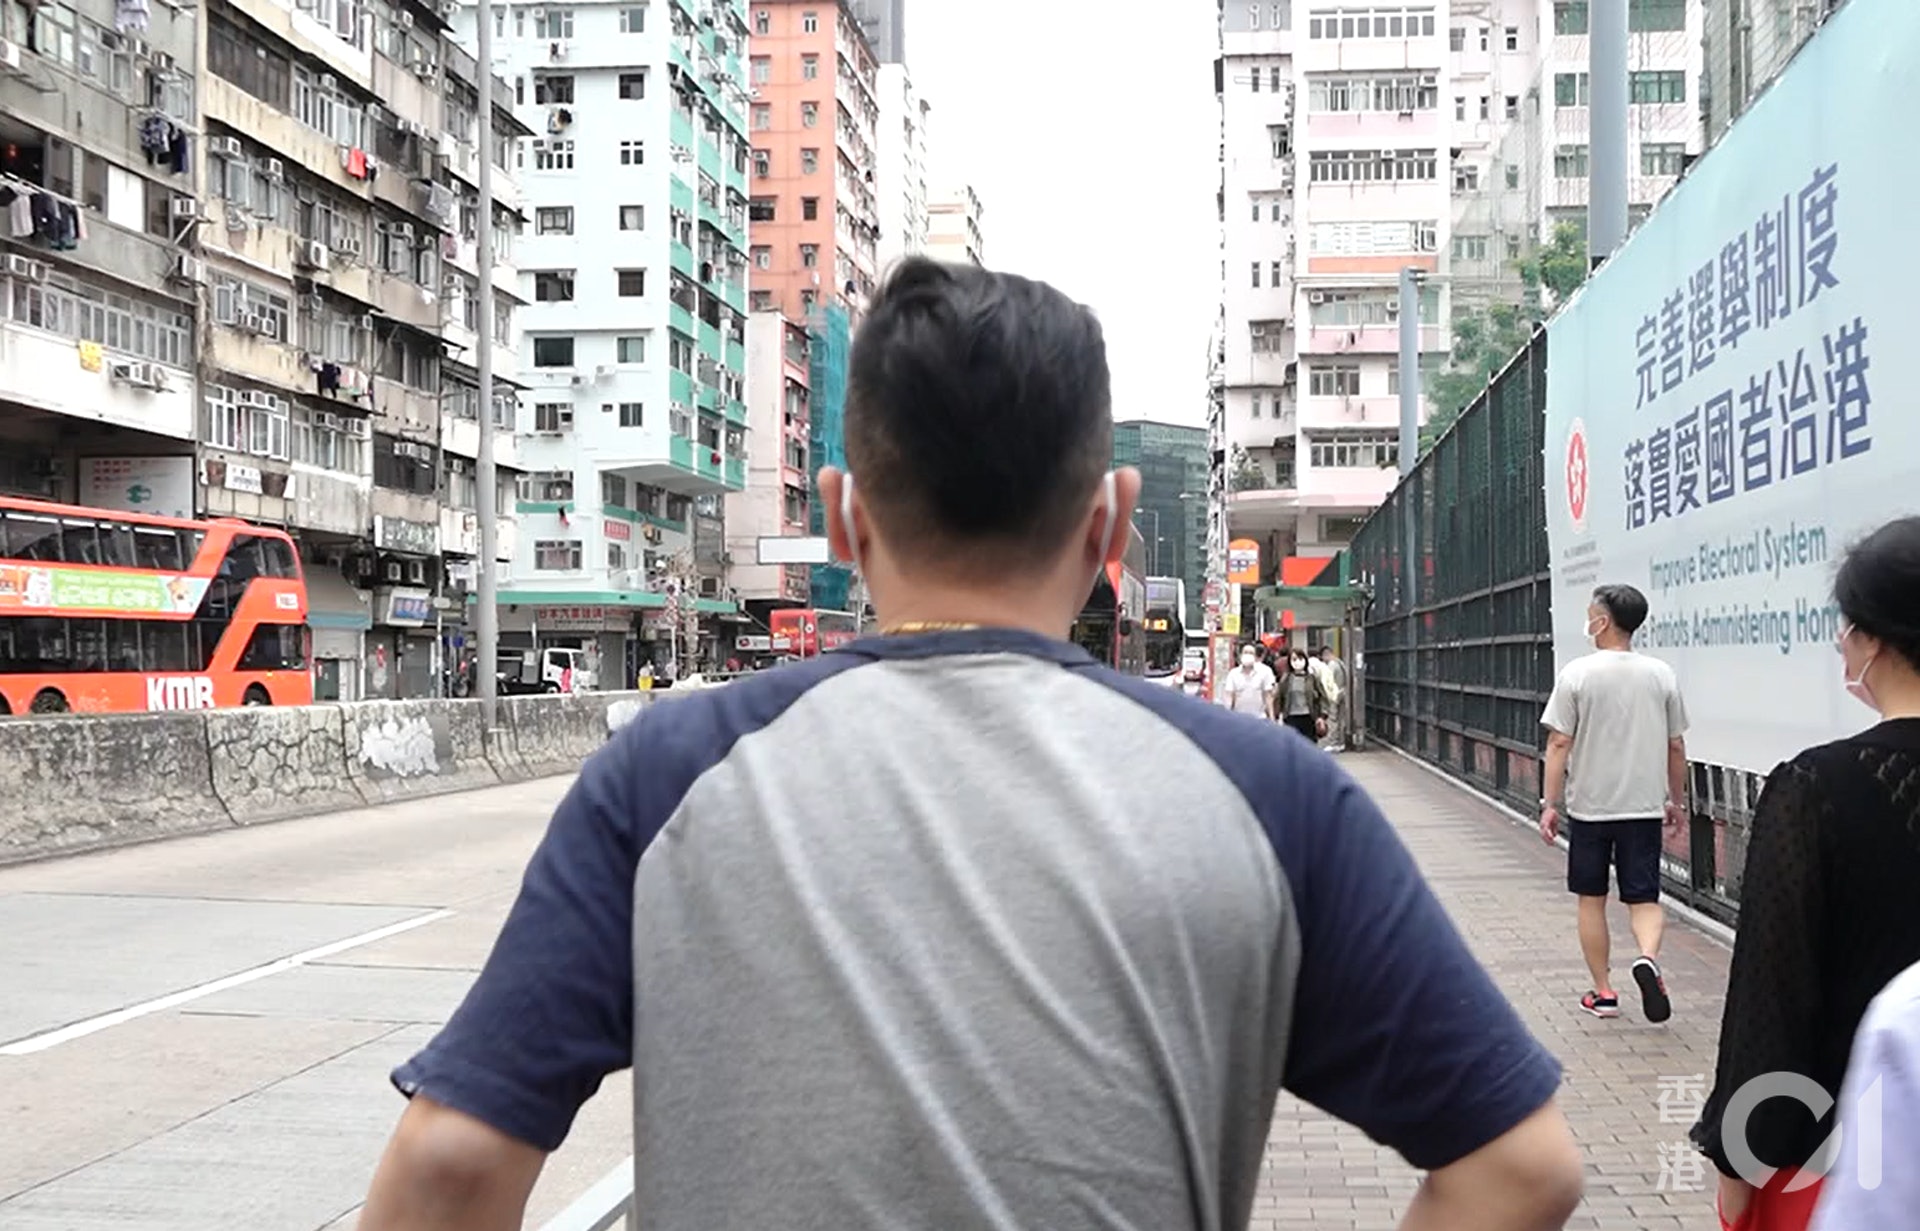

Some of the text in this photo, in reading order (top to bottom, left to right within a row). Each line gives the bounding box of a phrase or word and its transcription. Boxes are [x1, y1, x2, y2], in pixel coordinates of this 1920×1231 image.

[1635, 162, 1840, 410] 完善選舉制度
[1624, 316, 1872, 530] 落實愛國者治港
[1650, 556, 1696, 597] Improve
[1699, 531, 1760, 582] Electoral
[1763, 522, 1827, 580] System
[1650, 607, 1689, 648] Patriots
[1692, 600, 1791, 654] Administering
[147, 676, 215, 712] KMB
